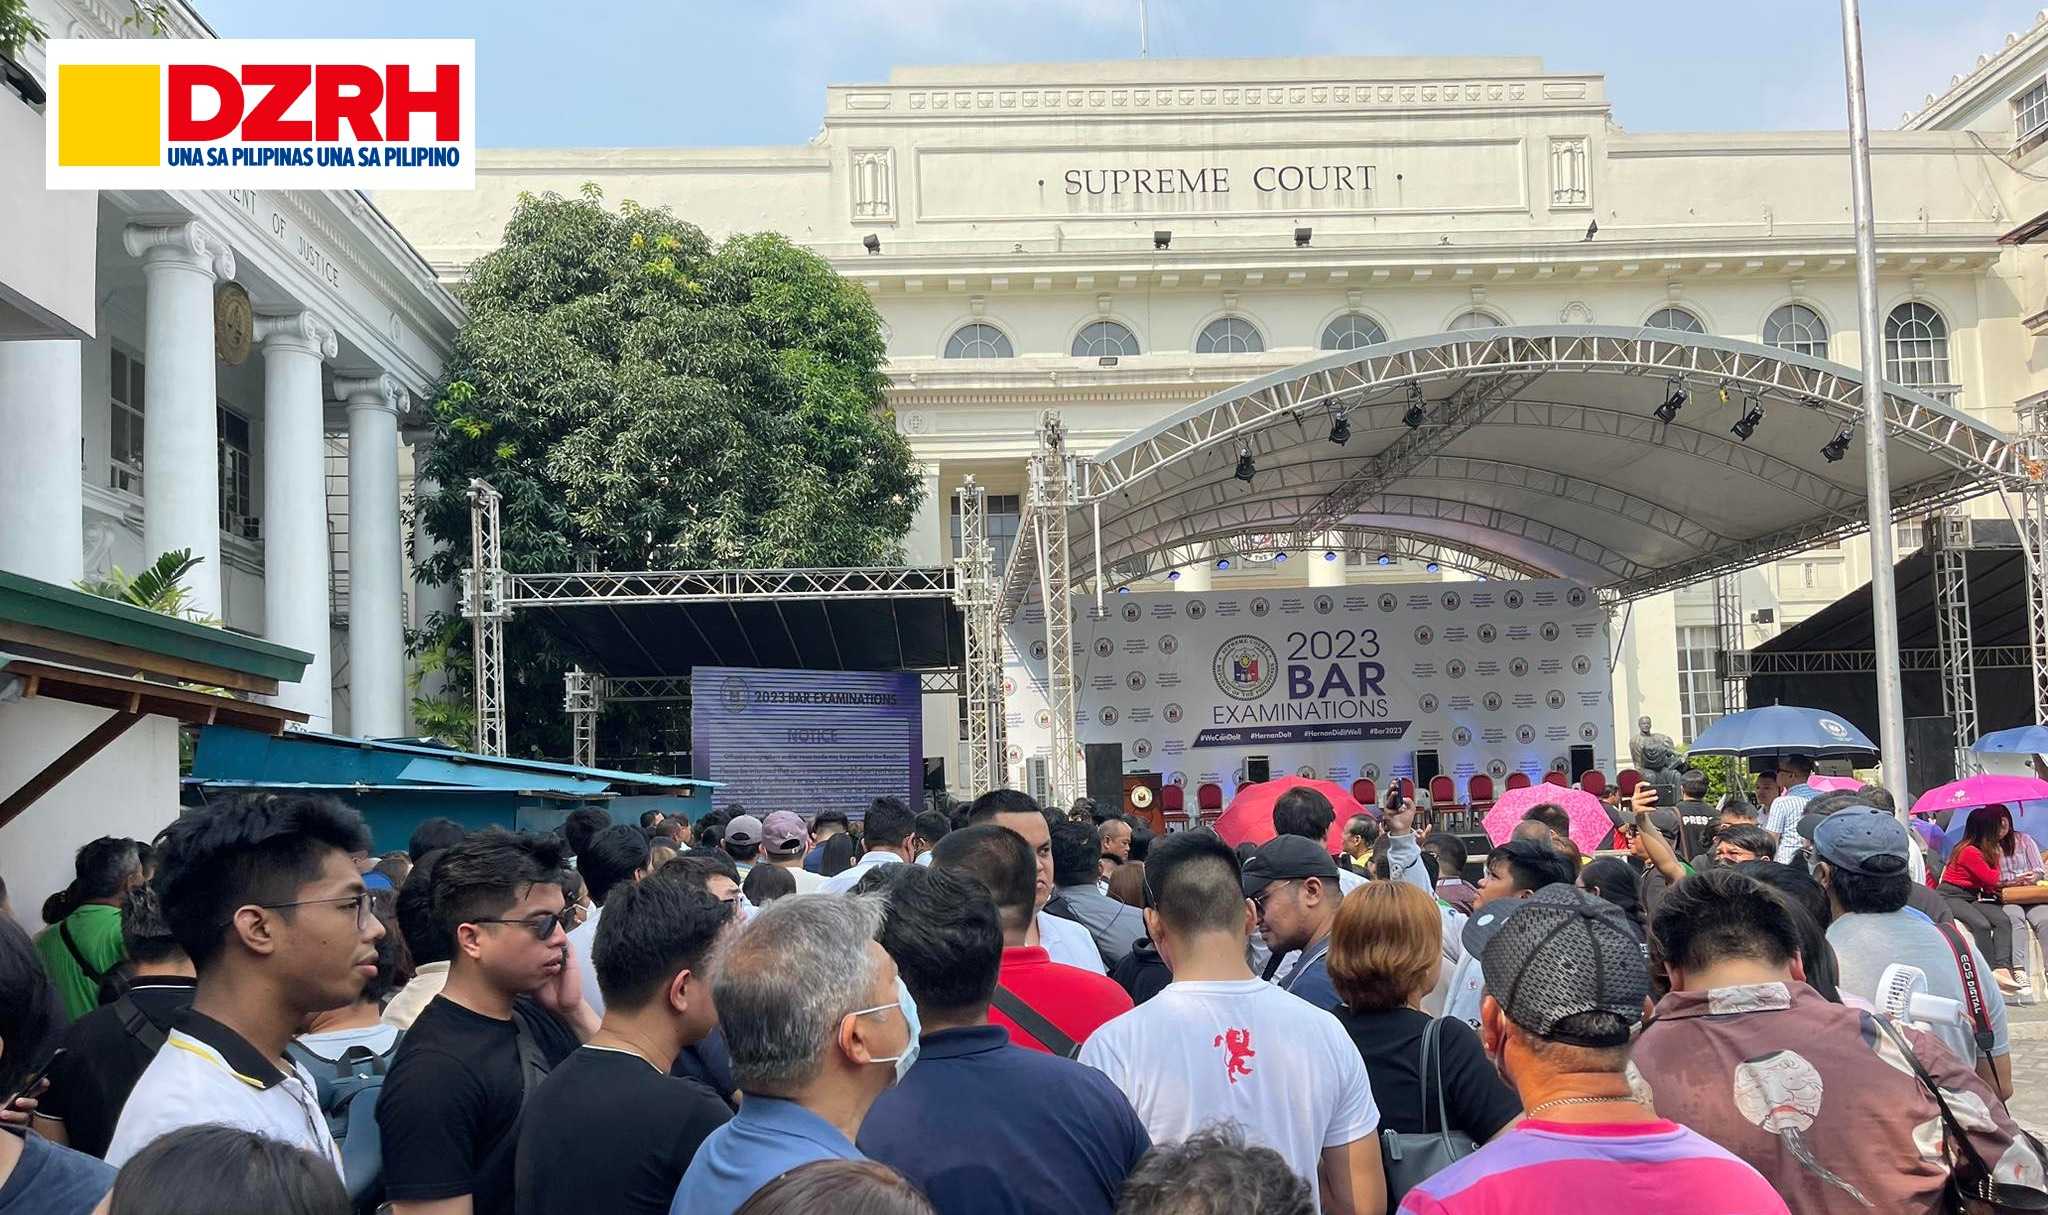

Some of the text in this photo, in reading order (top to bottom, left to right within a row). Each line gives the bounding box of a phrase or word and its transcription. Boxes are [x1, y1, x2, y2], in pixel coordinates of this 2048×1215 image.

[1063, 165, 1378, 196] SUPREME COURT
[272, 212, 287, 239] OF
[296, 235, 339, 289] JUSTICE
[1286, 629, 1381, 661] 2023
[1287, 661, 1387, 700] BAR
[754, 690, 897, 706] 2023 BAR EXAMINATIONS
[1212, 699, 1389, 725] EXAMINATIONS
[786, 728, 839, 744] NOTICE
[1369, 726, 1403, 736] #Bar2023
[1682, 815, 1713, 826] PRES
[1960, 954, 1974, 980] EOS
